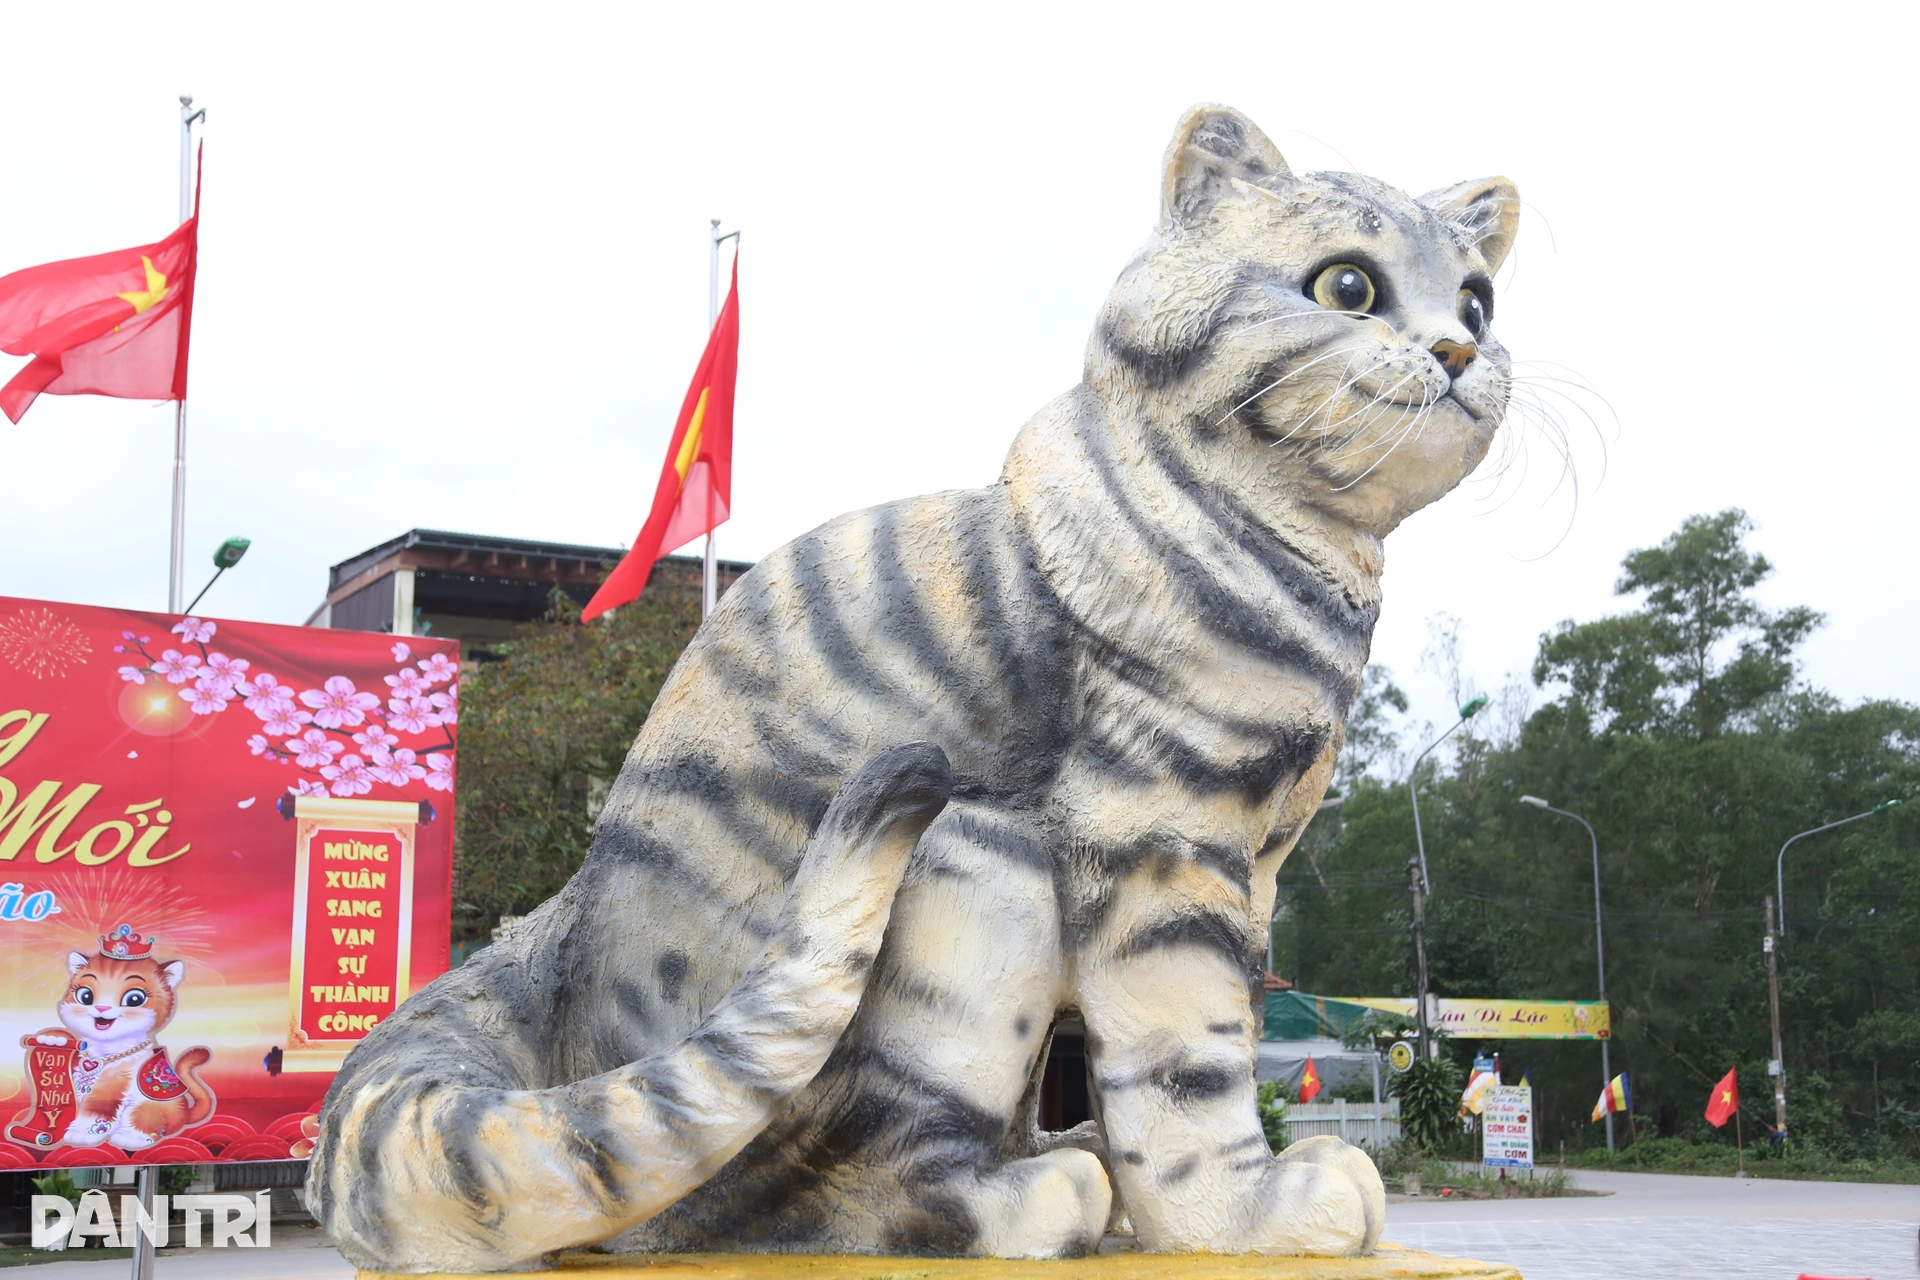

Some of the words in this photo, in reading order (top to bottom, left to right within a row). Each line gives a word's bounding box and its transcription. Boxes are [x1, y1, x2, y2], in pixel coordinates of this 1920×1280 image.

[0, 776, 191, 867] Mới
[324, 838, 389, 862] MỪNG
[325, 867, 386, 889] XUÂN
[326, 899, 382, 918] SANG
[331, 928, 375, 949] VẠN
[337, 954, 368, 978] SỰ
[310, 981, 389, 1003] THÀNH
[318, 1011, 378, 1032] CÔNG
[36, 1051, 66, 1069] Vạn
[40, 1070, 66, 1088] Sự
[39, 1090, 72, 1107] Như
[44, 1108, 62, 1128] Ý
[1507, 1125, 1526, 1134] CHAY
[1505, 1149, 1527, 1159] CƠM
